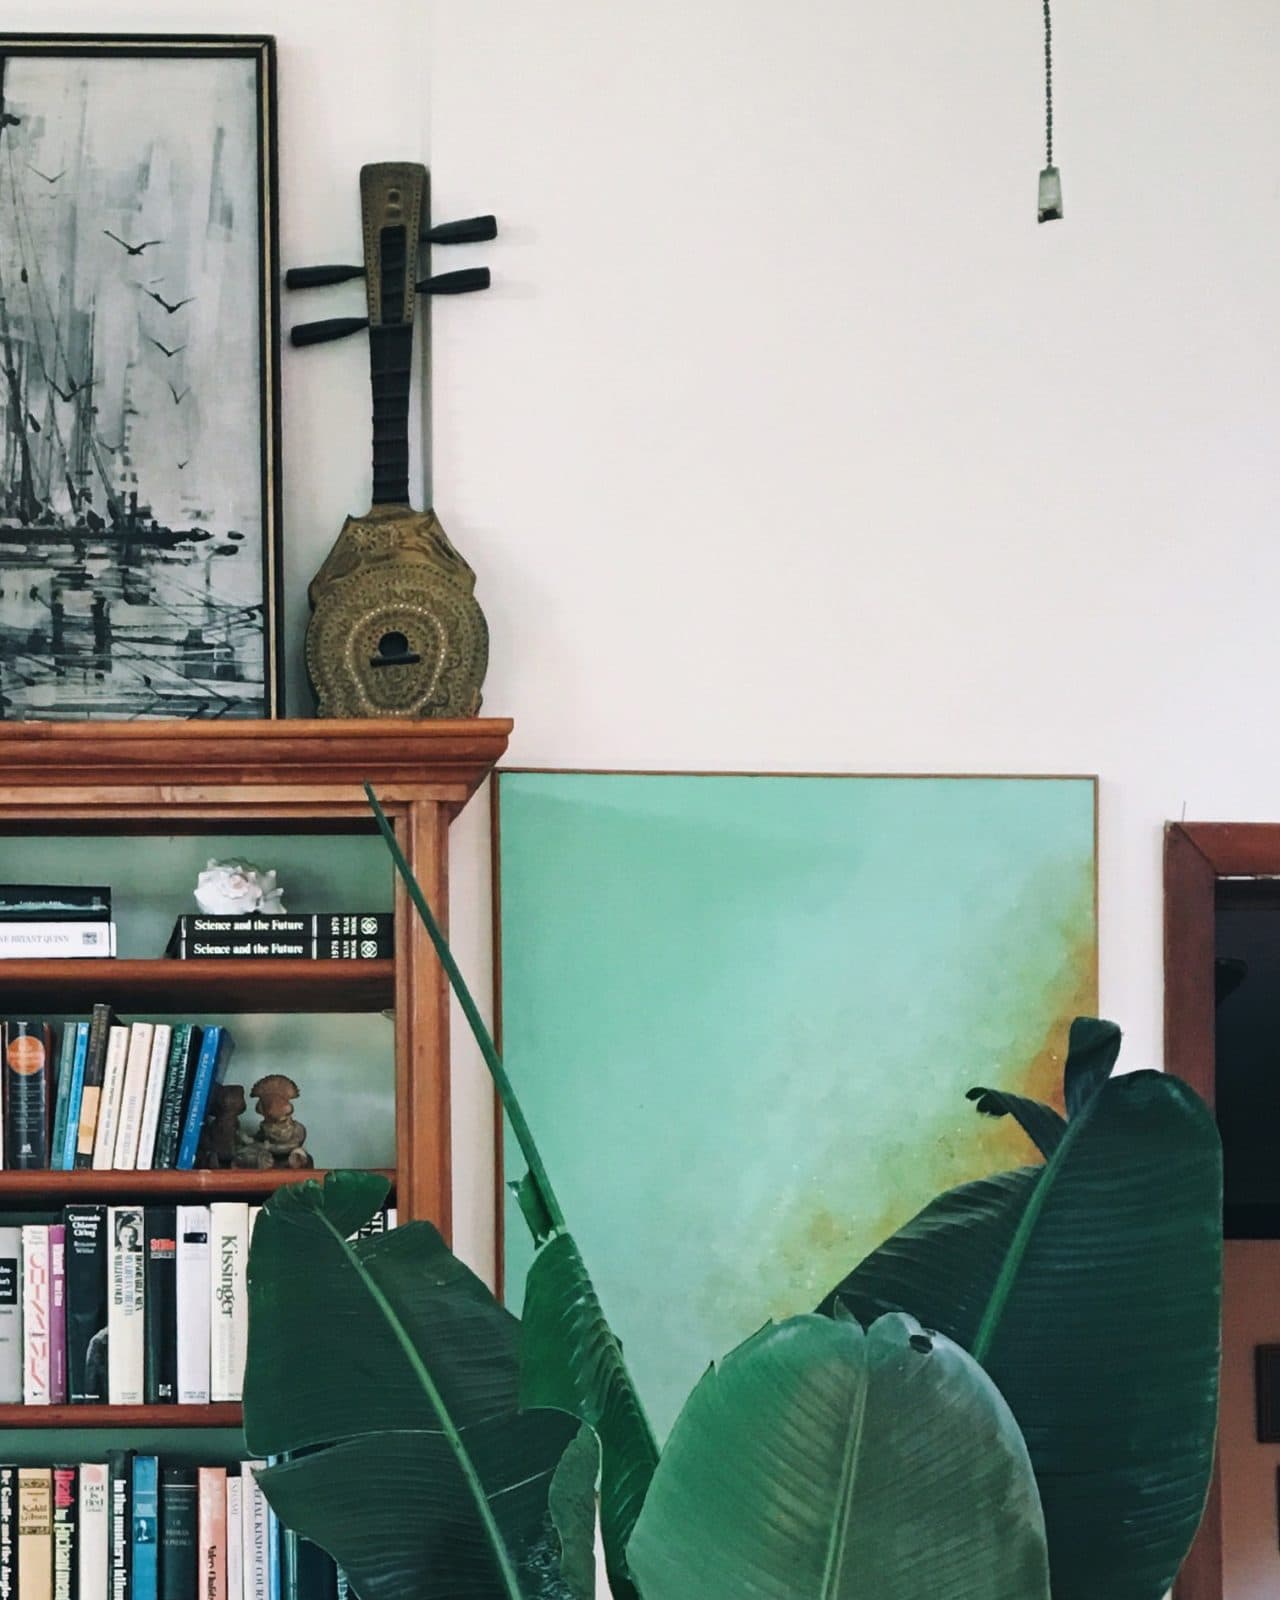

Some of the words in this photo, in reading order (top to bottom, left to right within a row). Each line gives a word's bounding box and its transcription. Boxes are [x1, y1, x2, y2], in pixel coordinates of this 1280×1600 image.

[194, 919, 230, 931] Science
[233, 919, 251, 930] and
[253, 919, 270, 930] the
[272, 919, 304, 931] Future
[194, 943, 230, 955] Science
[233, 943, 251, 954] and
[253, 942, 270, 954] the
[272, 942, 304, 954] Future
[217, 1235, 239, 1318] Kissinger
[0, 1470, 11, 1486] De
[54, 1470, 74, 1508] Death
[0, 1488, 11, 1522] Gaulle
[0, 1524, 11, 1543] and
[254, 1522, 264, 1552] KIND
[0, 1546, 11, 1562] the
[254, 1554, 264, 1566] OF
